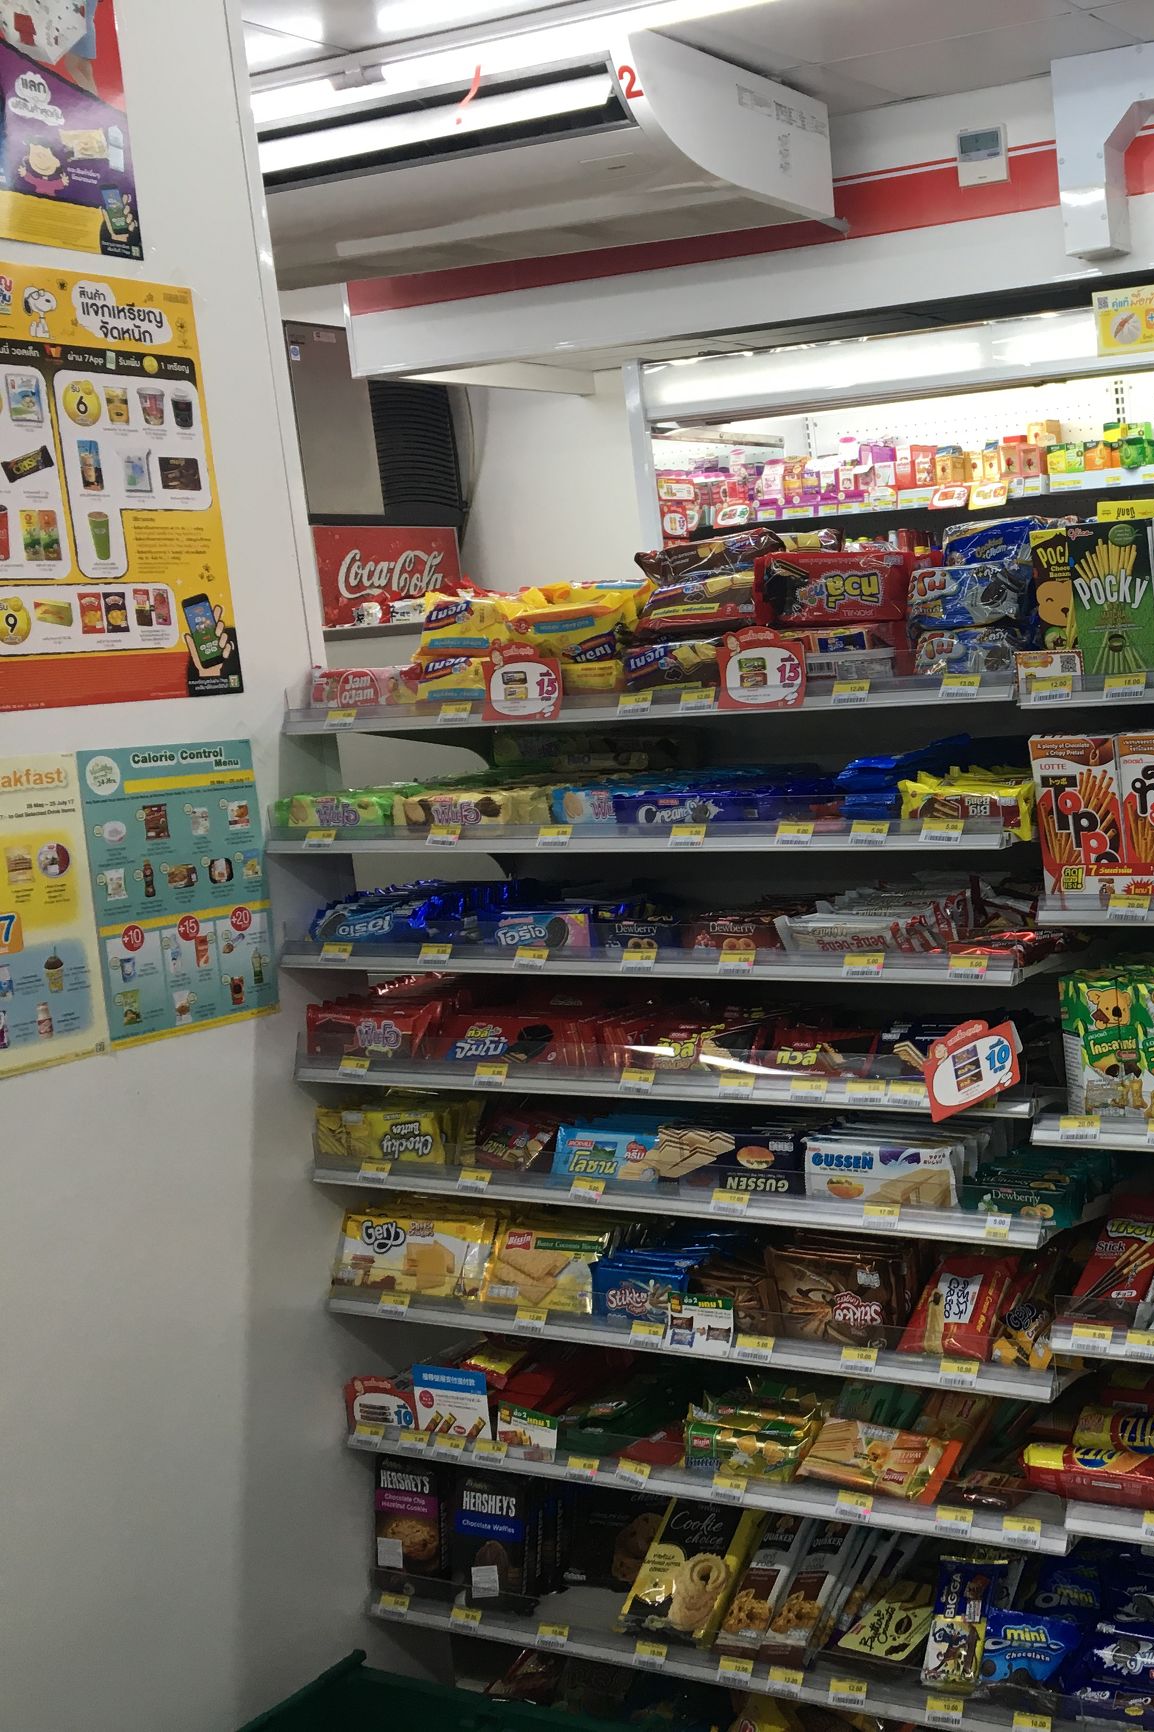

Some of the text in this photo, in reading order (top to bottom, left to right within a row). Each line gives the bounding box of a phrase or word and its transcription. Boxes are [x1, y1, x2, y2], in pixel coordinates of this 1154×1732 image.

[616, 64, 643, 99] 2
[76, 396, 88, 415] 6
[338, 548, 445, 599] Coca-Cola
[1073, 569, 1149, 610] Pocky
[5, 613, 17, 633] 9
[776, 662, 800, 683] 15
[536, 678, 558, 696] 15
[132, 747, 223, 765] Calorie Control
[214, 759, 239, 768] Menu
[1040, 763, 1066, 771] LOTTE
[615, 923, 657, 936] Dewberry
[709, 922, 755, 935] Dewberry
[985, 1045, 1011, 1071] 10
[811, 1151, 874, 1170] GUSSEN
[992, 1188, 1041, 1205] Dewberry
[362, 1220, 405, 1253] Gery
[670, 1509, 724, 1533] Cookie
[763, 1532, 795, 1544] QUAKER
[1005, 1628, 1047, 1643] mini
[1005, 1651, 1051, 1662] Chocolate
